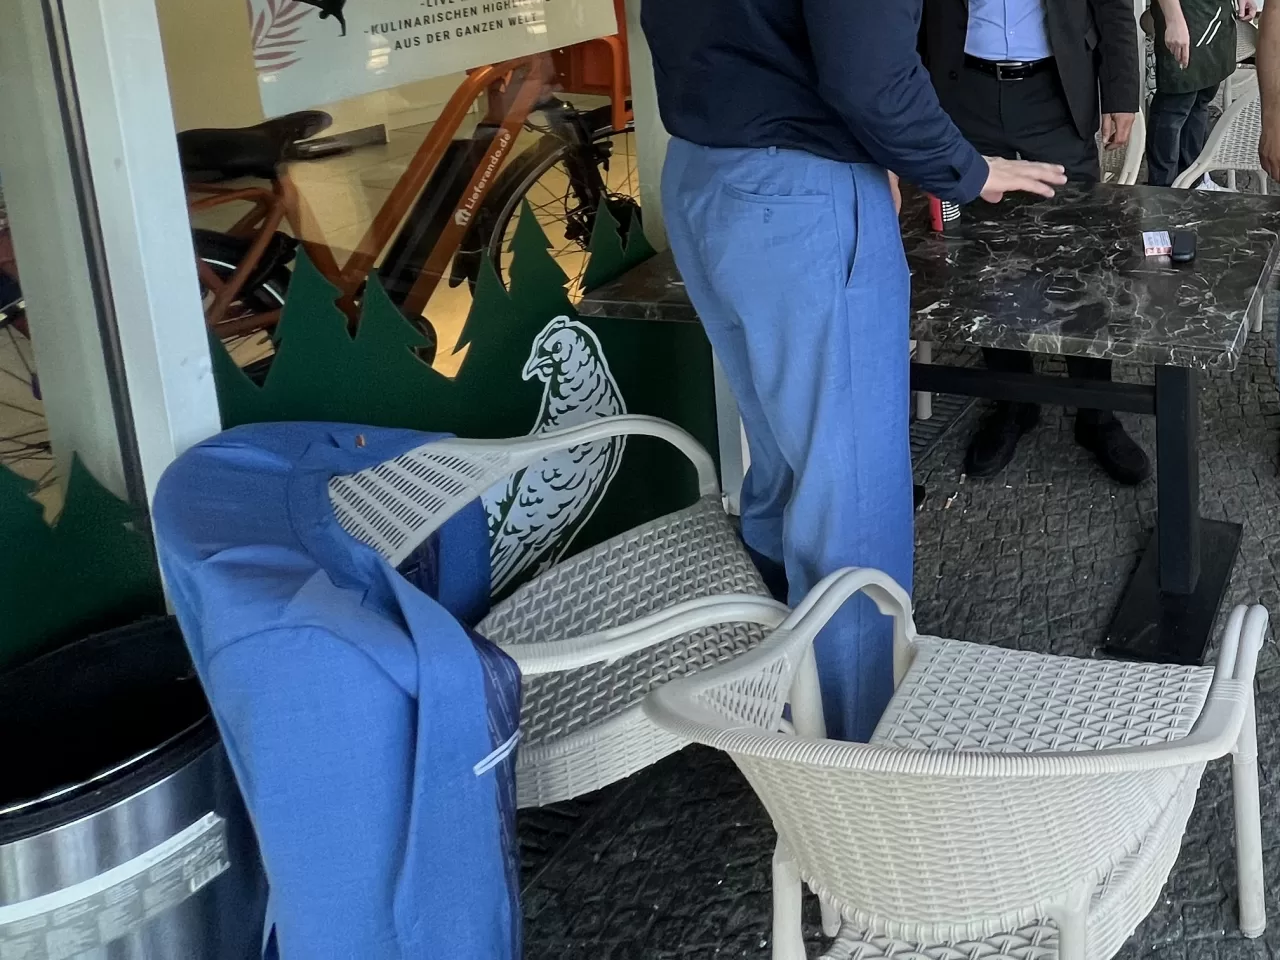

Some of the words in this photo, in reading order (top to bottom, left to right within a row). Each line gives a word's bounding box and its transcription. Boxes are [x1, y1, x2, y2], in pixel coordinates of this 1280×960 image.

[394, 36, 421, 51] AUS
[427, 30, 451, 44] DER
[455, 20, 503, 38] GANZEN
[508, 12, 537, 26] WELT
[465, 133, 511, 210] Lieferando.de
